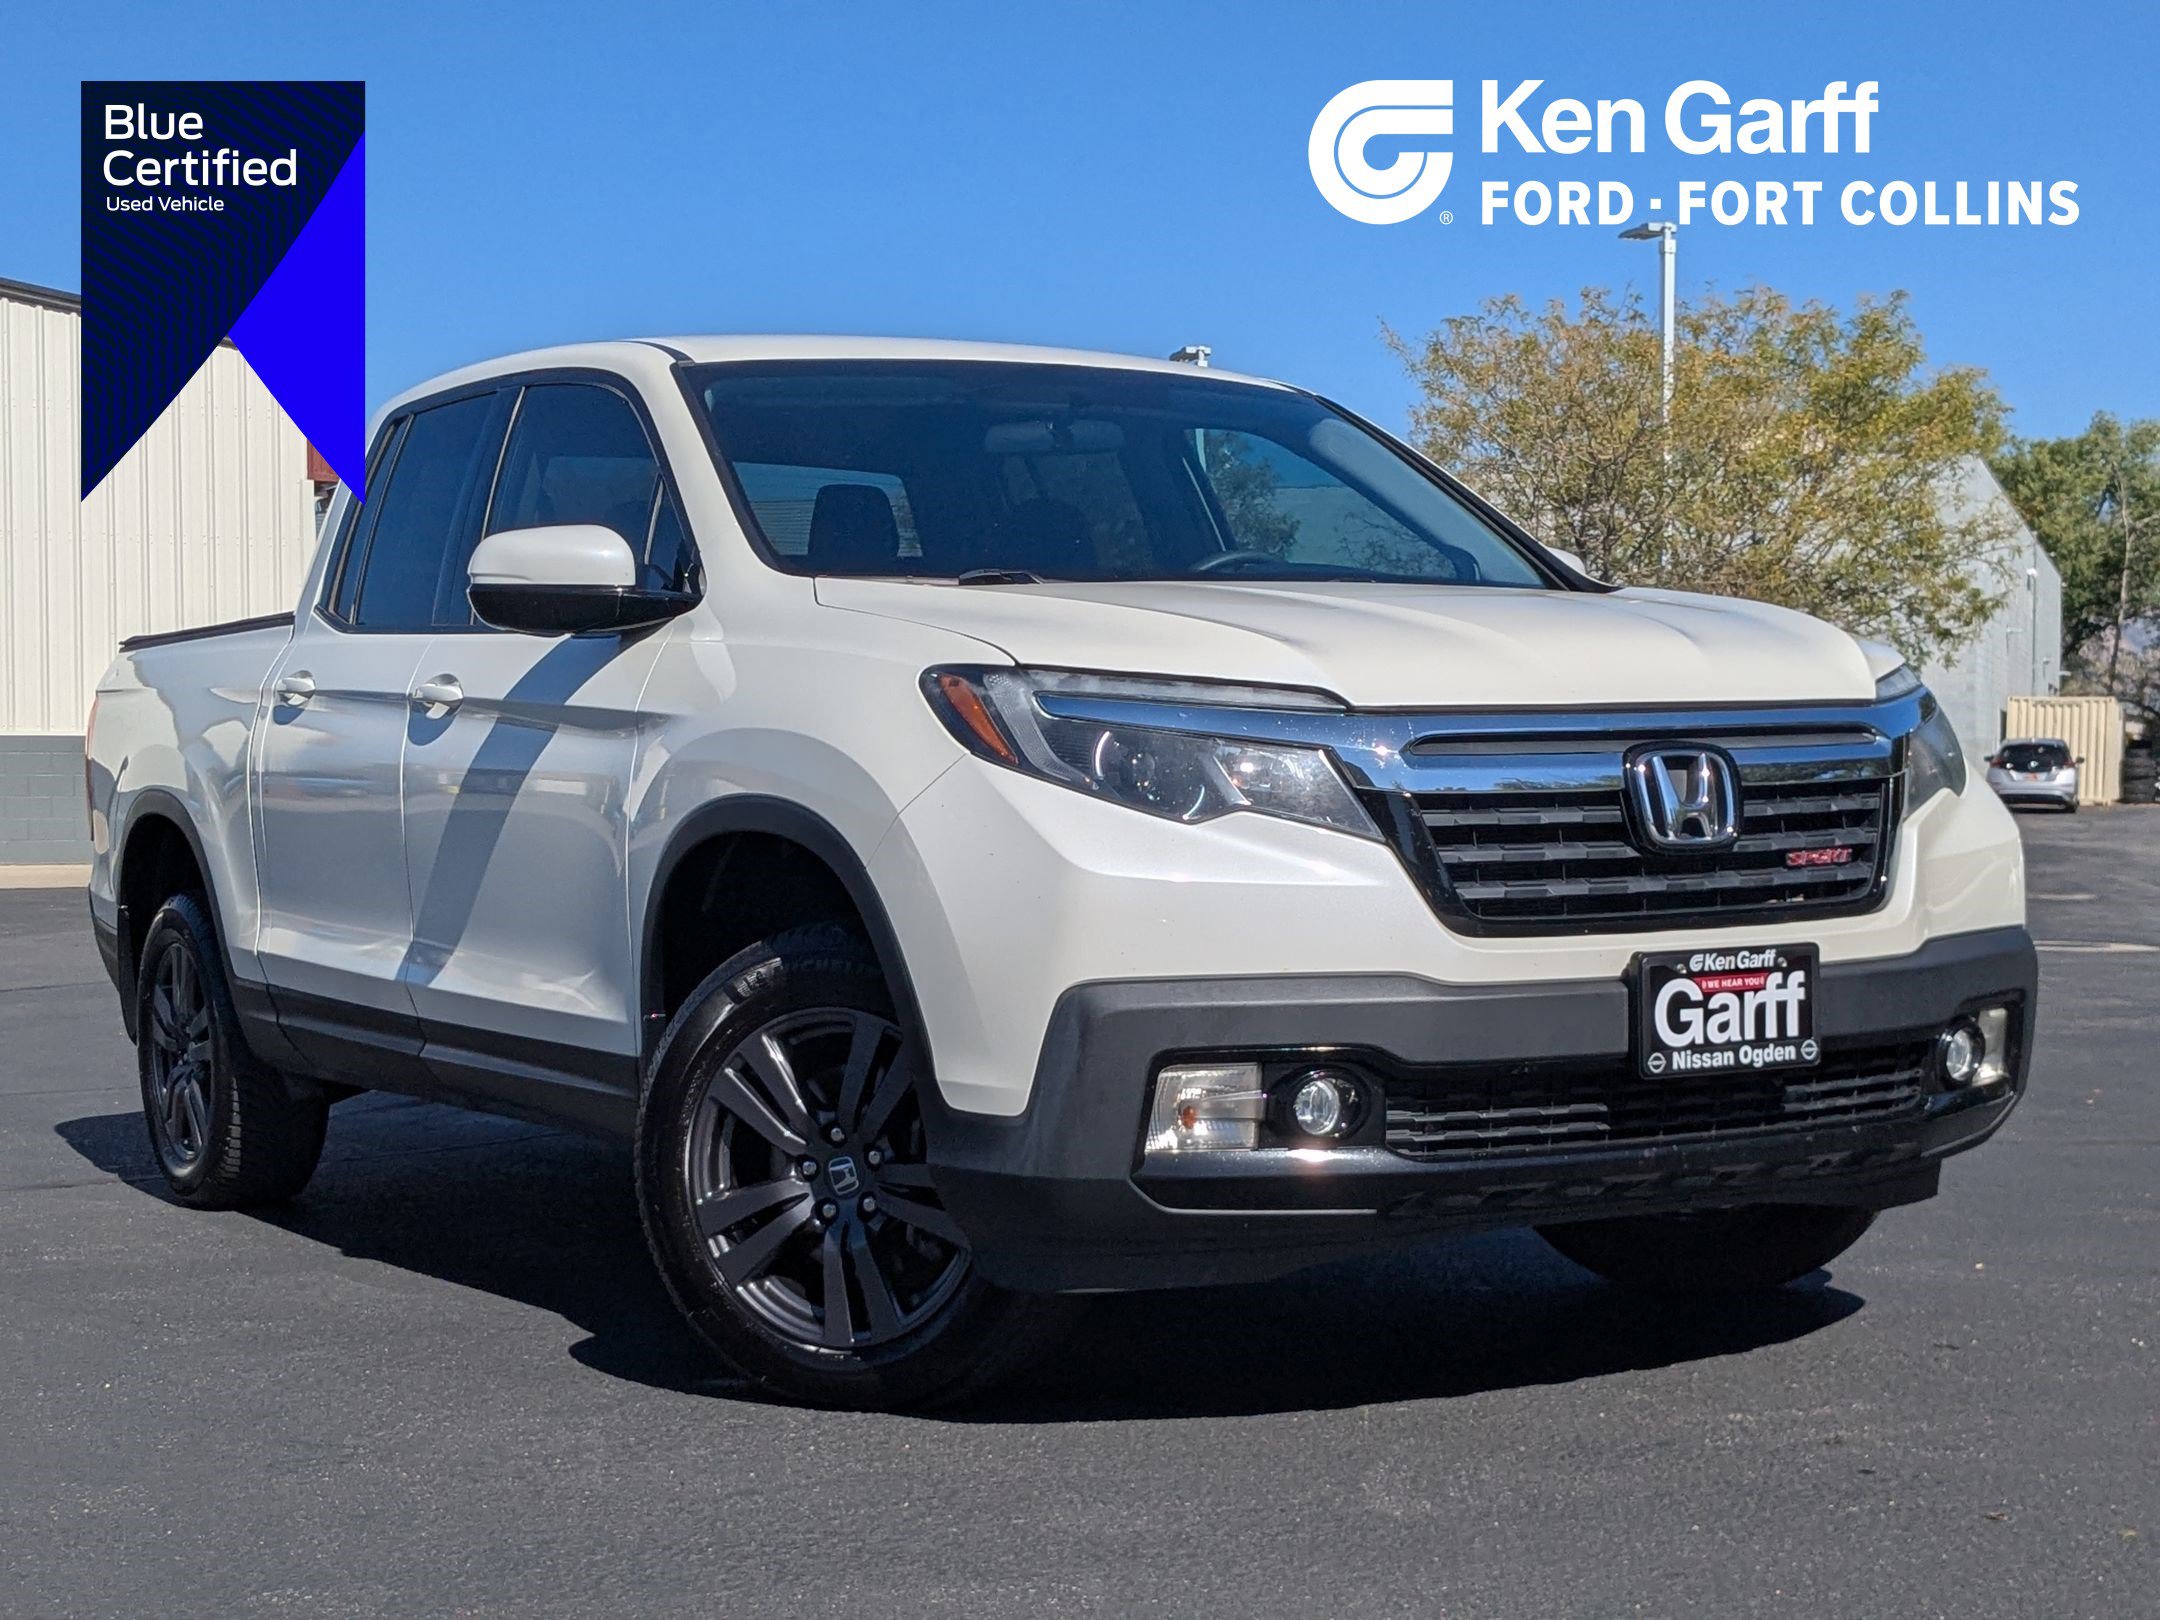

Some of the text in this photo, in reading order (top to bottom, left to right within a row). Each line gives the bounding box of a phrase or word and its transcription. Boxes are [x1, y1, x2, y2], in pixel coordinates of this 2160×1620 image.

[1703, 949, 1777, 971] Ken Garff
[1707, 976, 1760, 989] WE HEAR YOU
[1653, 970, 1806, 1049] Garff
[1671, 1043, 1797, 1071] Nissan Ogden
